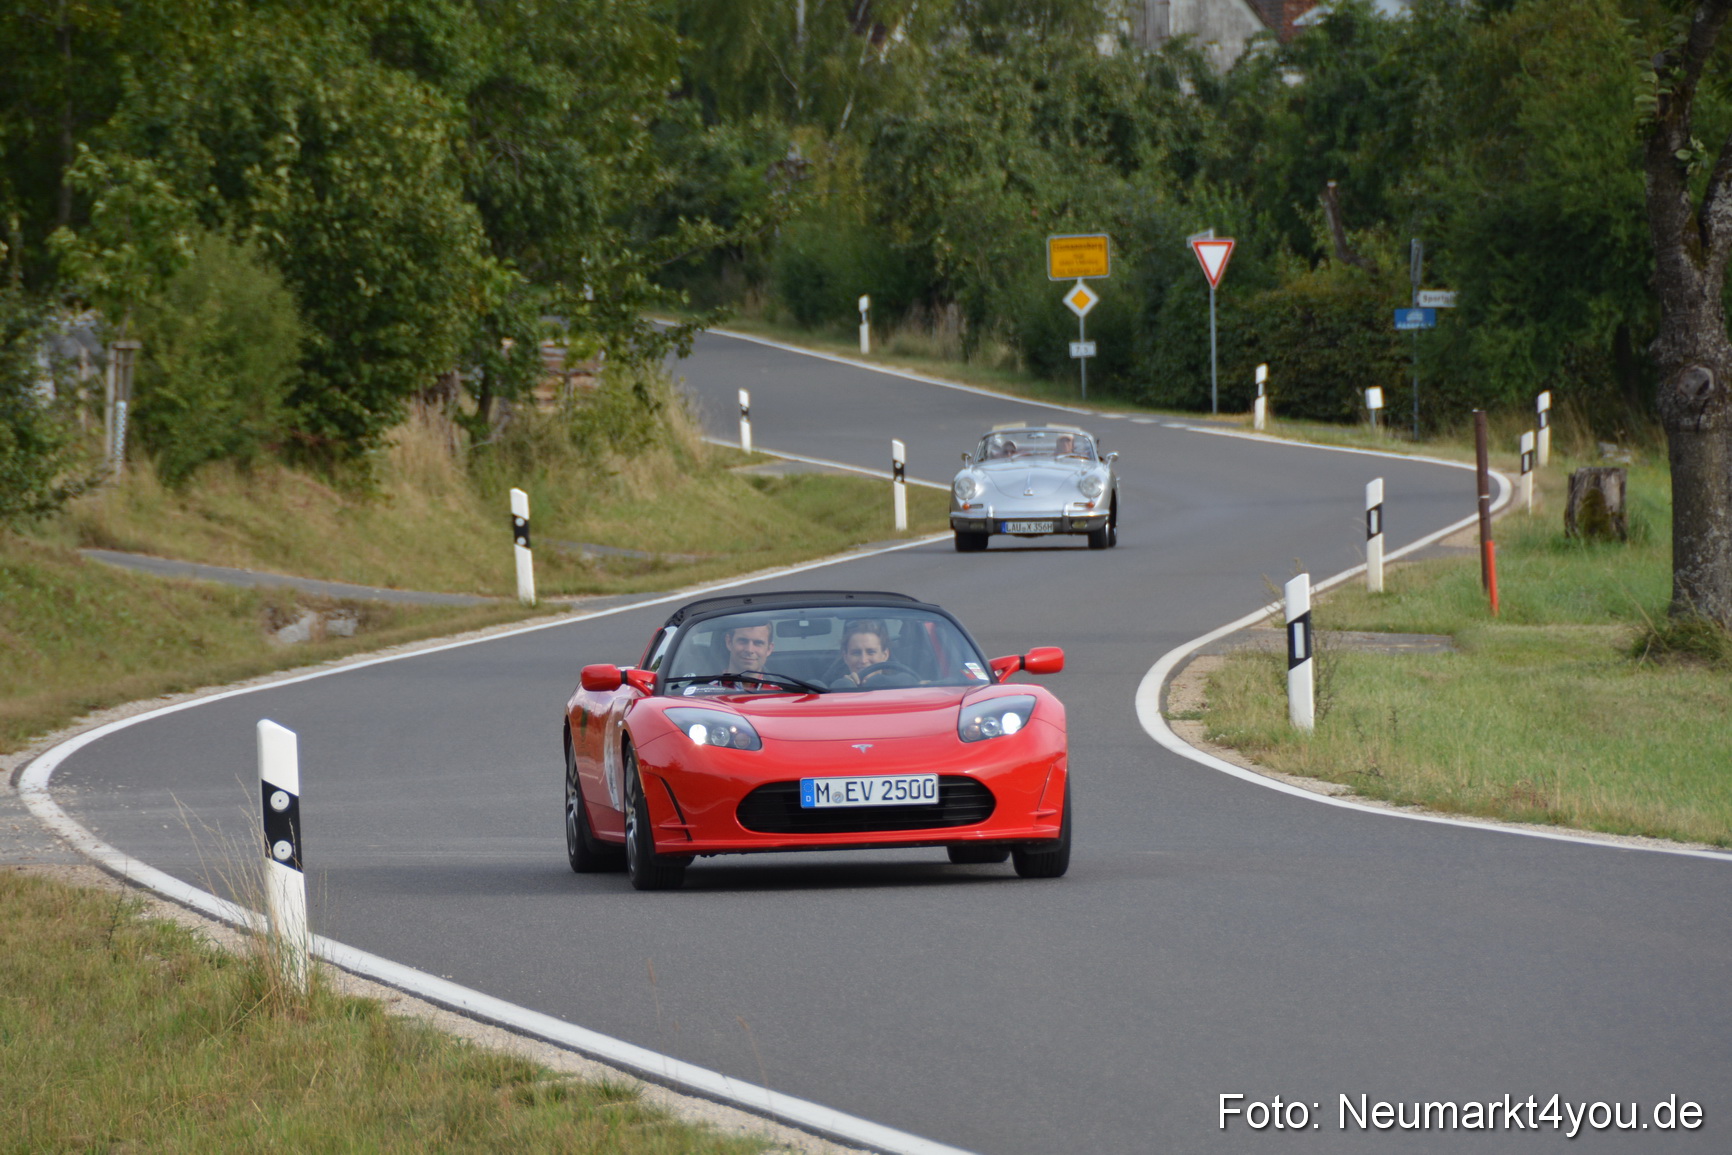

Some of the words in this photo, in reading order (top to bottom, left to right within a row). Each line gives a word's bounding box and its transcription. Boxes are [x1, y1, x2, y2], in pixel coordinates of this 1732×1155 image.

[1006, 523, 1021, 532] LAU
[1027, 523, 1032, 532] X
[815, 782, 830, 803] M
[845, 781, 873, 802] EV
[881, 778, 935, 801] 2500
